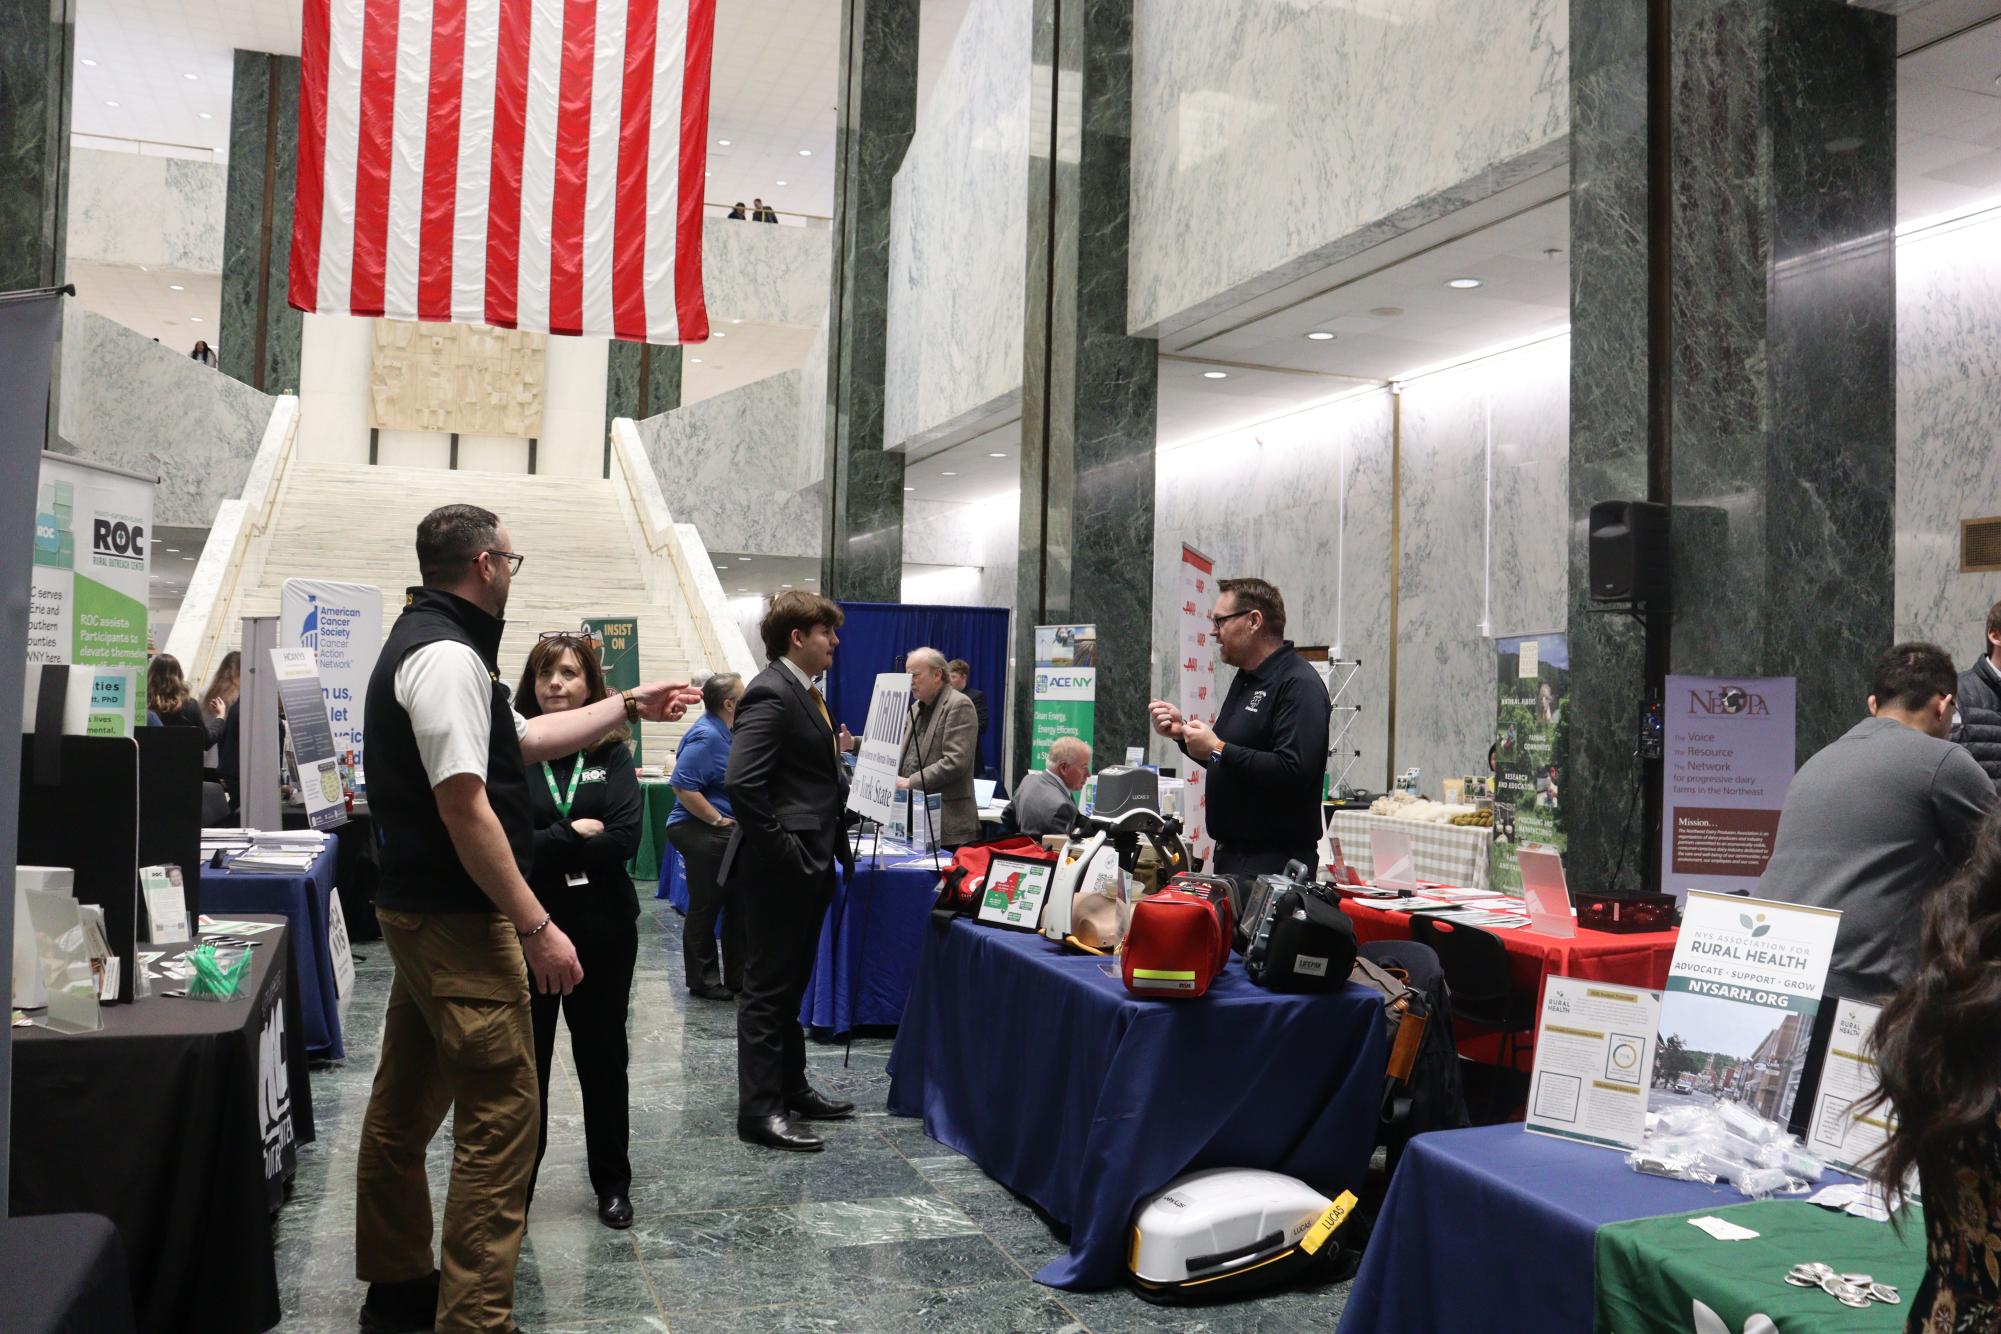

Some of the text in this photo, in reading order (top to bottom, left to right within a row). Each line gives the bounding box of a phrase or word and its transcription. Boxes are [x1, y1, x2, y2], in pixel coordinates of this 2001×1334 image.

[94, 518, 143, 557] ROC
[46, 604, 60, 616] and
[320, 606, 361, 618] American
[80, 614, 99, 626] ROC
[320, 617, 350, 627] Cancer
[320, 627, 351, 638] Society
[604, 623, 633, 636] INSIST
[320, 639, 348, 648] Cancer
[611, 637, 625, 650] ON
[320, 649, 344, 659] Action
[320, 660, 352, 669] Network
[1049, 677, 1092, 688] ACE NY
[333, 688, 352, 702] us,
[331, 706, 348, 722] let
[1687, 731, 1716, 742] Voice
[1687, 746, 1734, 757] Resource
[1687, 760, 1731, 771] Network
[581, 769, 607, 782] ROC
[1673, 773, 1756, 786] for progressive dairy
[873, 779, 892, 807] State
[1673, 785, 1697, 794] farms
[1708, 786, 1721, 794] the
[1723, 787, 1763, 796] Northeast
[1694, 931, 1810, 956] NYS ASSOCIATION FOR
[1690, 940, 1808, 970] RURAL HEALTH
[1674, 961, 1816, 992] ADVOCATE SUPPORT GROW
[1688, 980, 1790, 1008] NYSARH.ORG
[1548, 998, 1571, 1007] RURAL
[1547, 1005, 1571, 1014] HEALTH
[1840, 1020, 1862, 1031] RURAL
[1839, 1028, 1860, 1037] HEALTH
[1321, 1204, 1345, 1231] LUCAS
[1293, 1220, 1312, 1236] LUCAS
